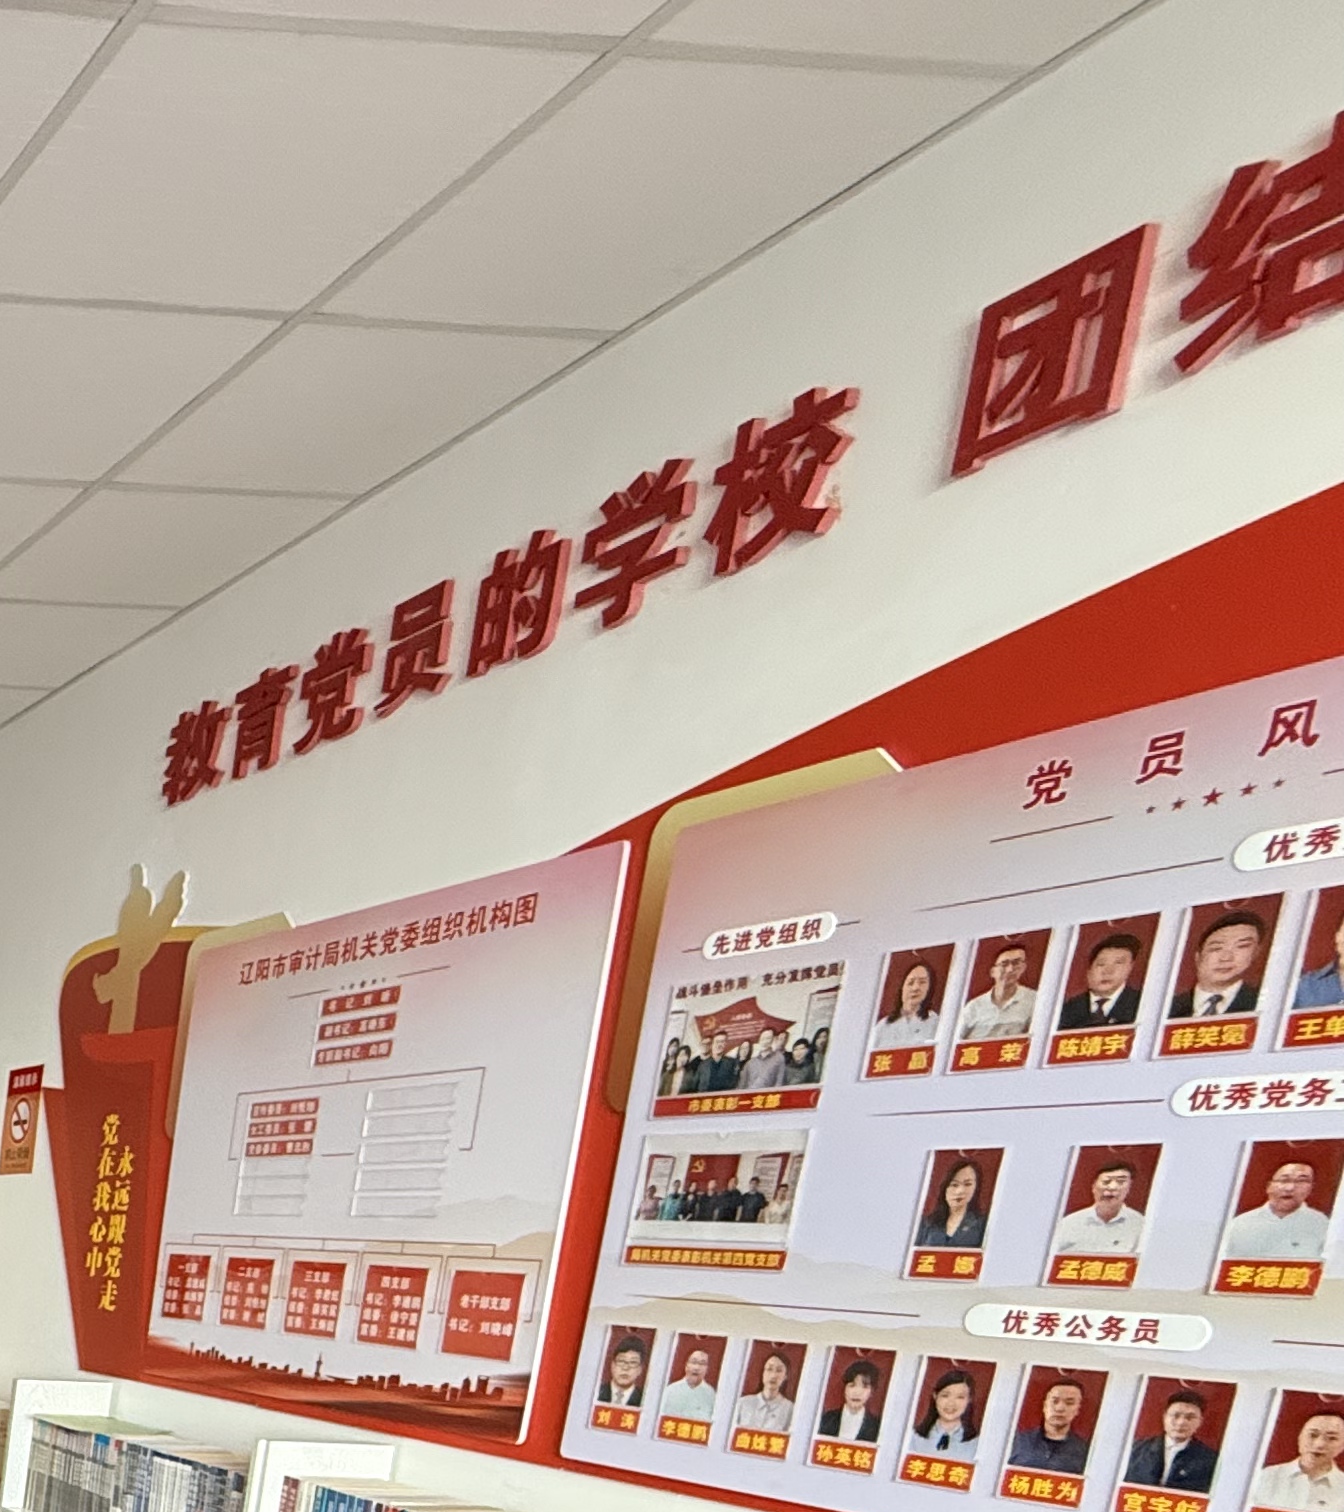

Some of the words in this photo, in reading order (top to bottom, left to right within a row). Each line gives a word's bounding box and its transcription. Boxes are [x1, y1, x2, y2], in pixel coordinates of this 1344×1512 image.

[160, 386, 861, 808] 教育党员的学校
[950, 110, 1344, 480] 团结
[1023, 699, 1319, 809] 党员风
[238, 892, 539, 985] 辽阳市审计局机关党委组织机构图
[712, 917, 823, 956] 先进党组织
[761, 961, 844, 987] 充分发挥党员
[1188, 1077, 1344, 1112] 优秀党务
[85, 1113, 120, 1277] 党在我心中
[98, 1145, 134, 1311] 永远跟党走
[1001, 1310, 1160, 1344] 优秀公务员
[816, 1443, 873, 1469] 孙英铭
[906, 1459, 970, 1486] 李思奇
[1008, 1475, 1078, 1502] 杨胜为
